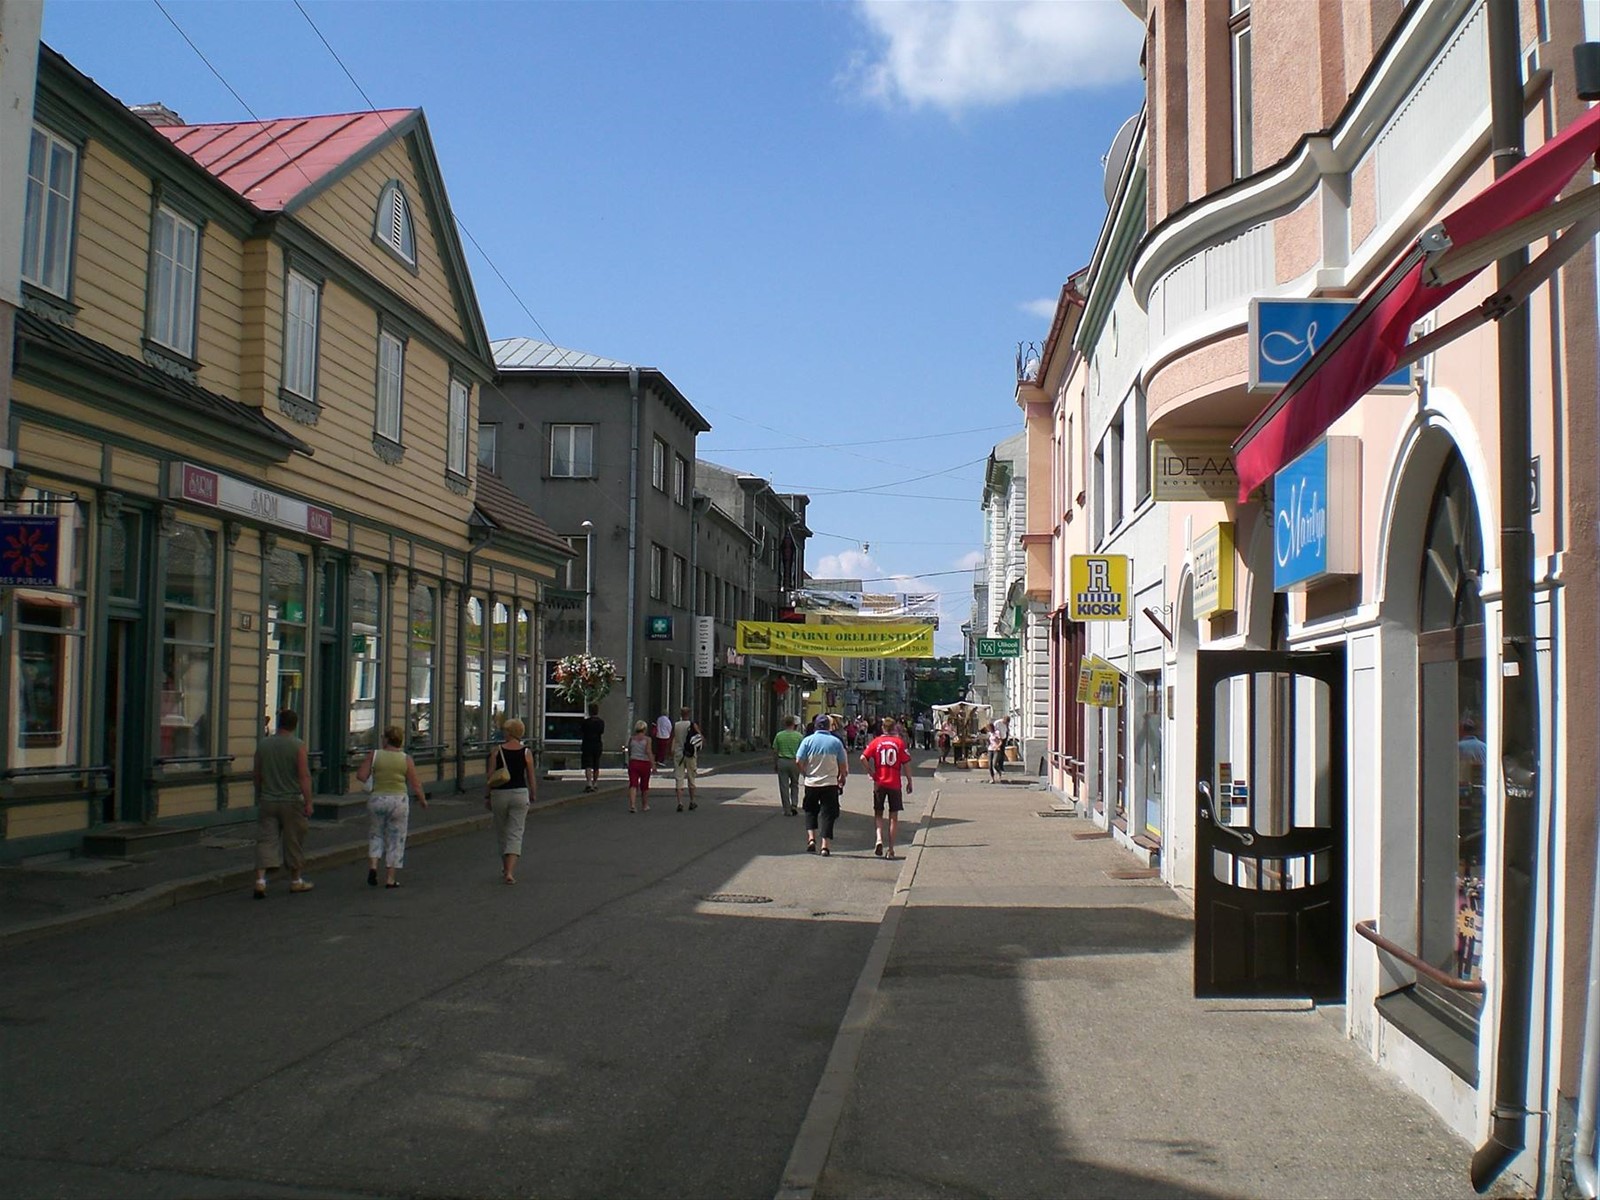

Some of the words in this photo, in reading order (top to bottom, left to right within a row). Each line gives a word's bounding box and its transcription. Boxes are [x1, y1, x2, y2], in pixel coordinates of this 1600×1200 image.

[1163, 457, 1238, 476] IDEAA
[16, 577, 54, 585] PUBLICA
[1087, 559, 1111, 593] R
[1077, 603, 1121, 615] KIOSK
[880, 748, 897, 766] 10
